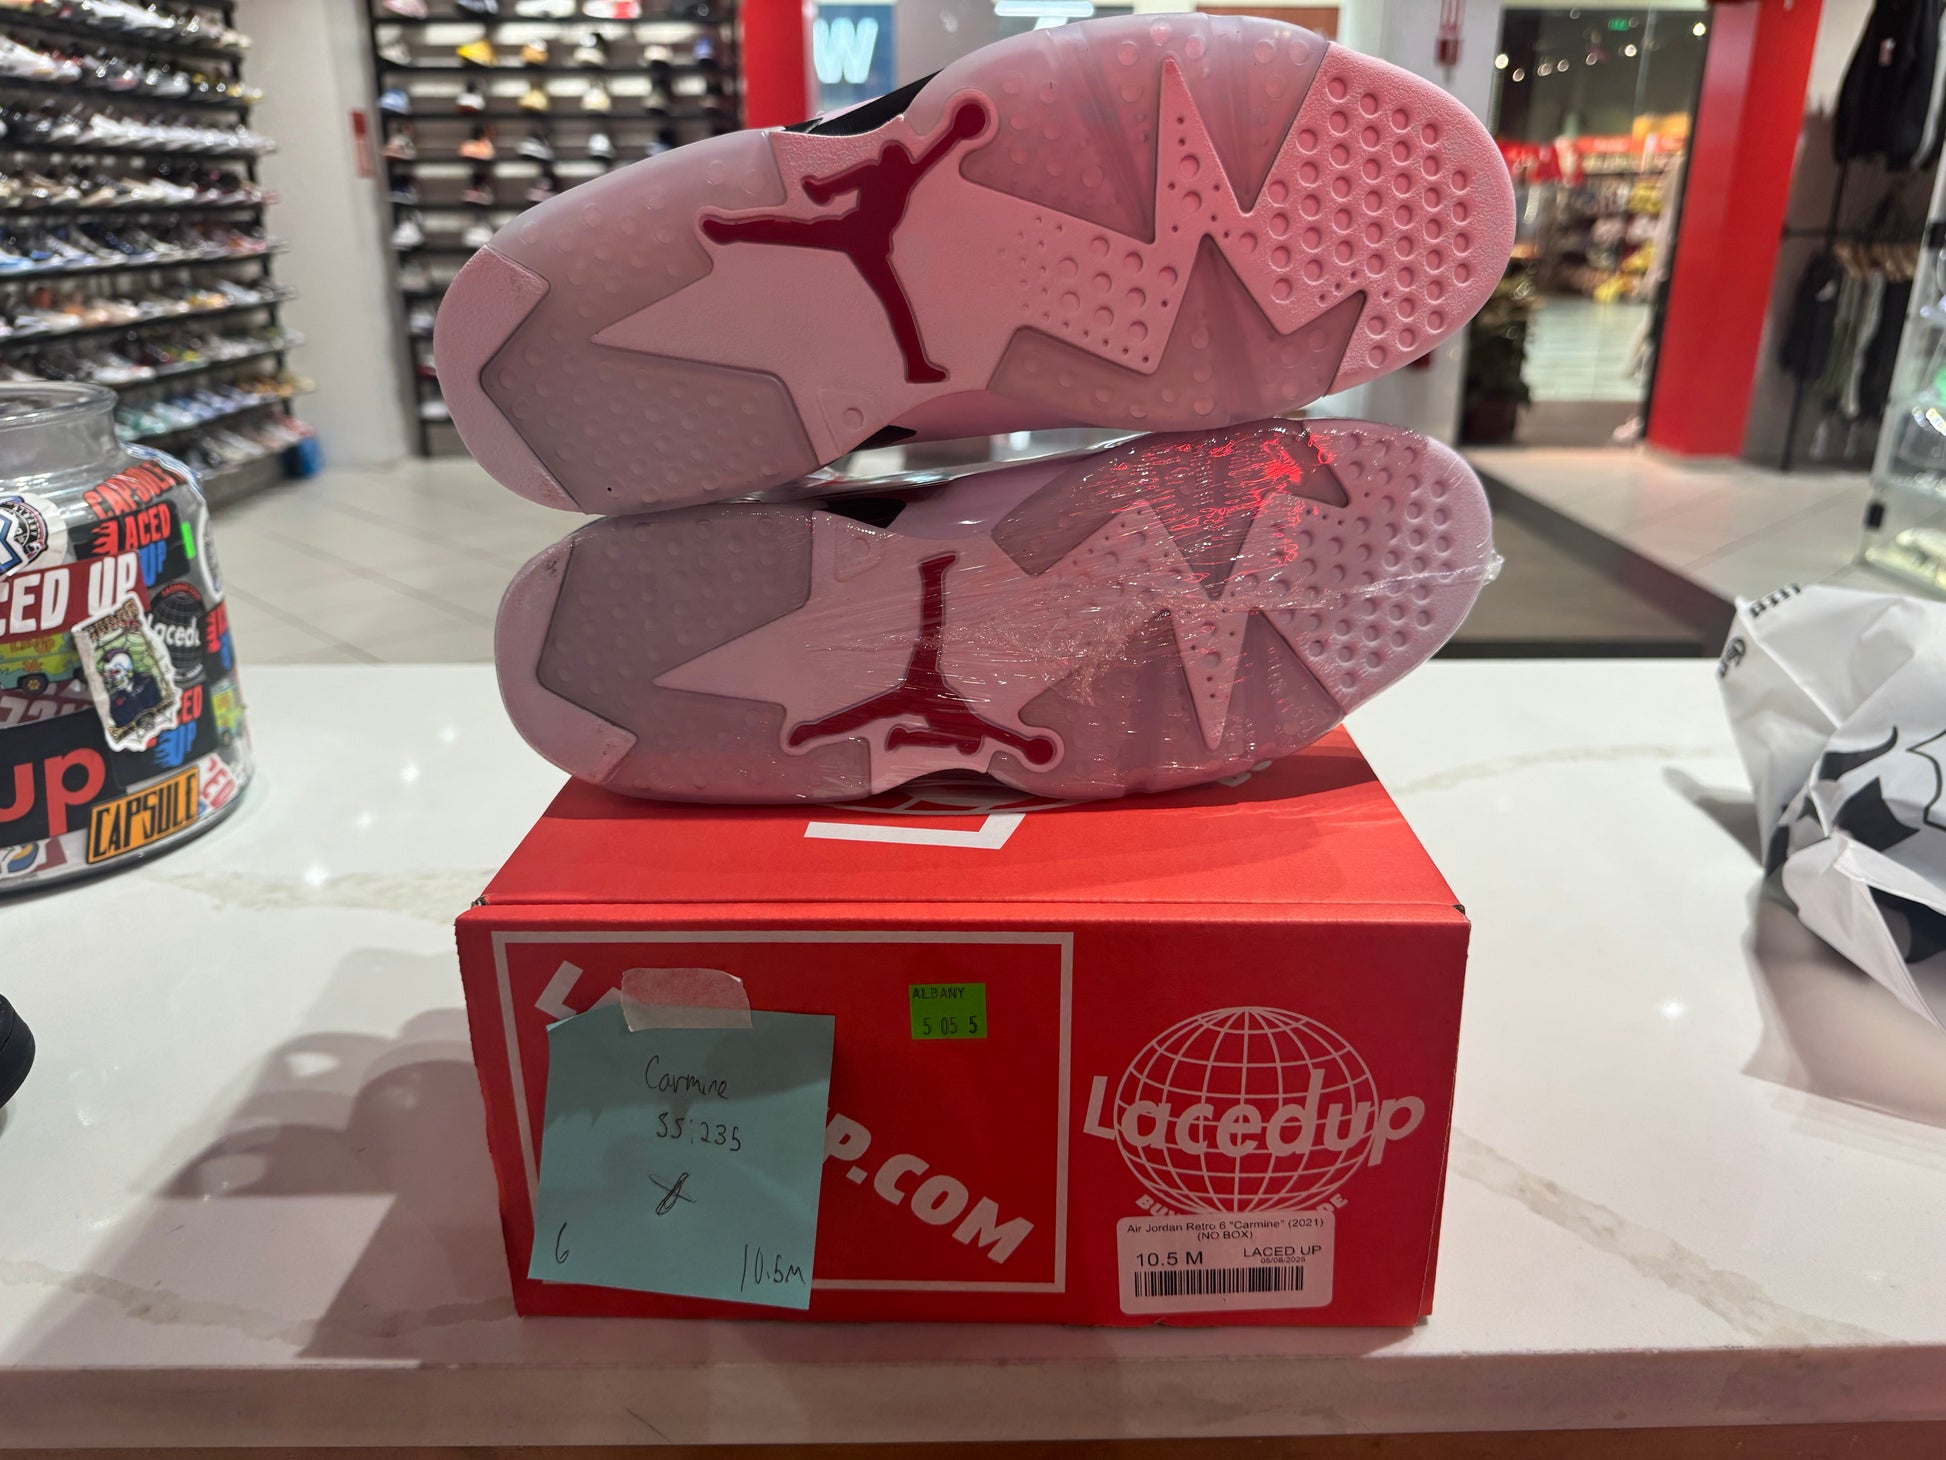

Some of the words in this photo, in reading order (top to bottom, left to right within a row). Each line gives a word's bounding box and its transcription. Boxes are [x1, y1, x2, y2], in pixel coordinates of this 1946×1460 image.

[88, 553, 137, 616] UP
[92, 773, 197, 857] CAPSULE
[911, 986, 966, 1000] ALBANY
[645, 1054, 729, 1100] Carmine
[1083, 1068, 1426, 1167] Lacedup
[1127, 1224, 1142, 1234] Air
[1146, 1223, 1183, 1233] Jordan
[1186, 1222, 1215, 1232] Retro
[1219, 1221, 1226, 1230] 6
[1229, 1219, 1285, 1230] "Carmine"
[1287, 1218, 1324, 1229] (2021)
[1197, 1231, 1220, 1242] (NO
[1222, 1230, 1253, 1241] BOX)
[1136, 1251, 1178, 1267] 10.5
[1185, 1250, 1203, 1266] M
[1243, 1245, 1296, 1258] LACED
[1300, 1245, 1322, 1256] UP
